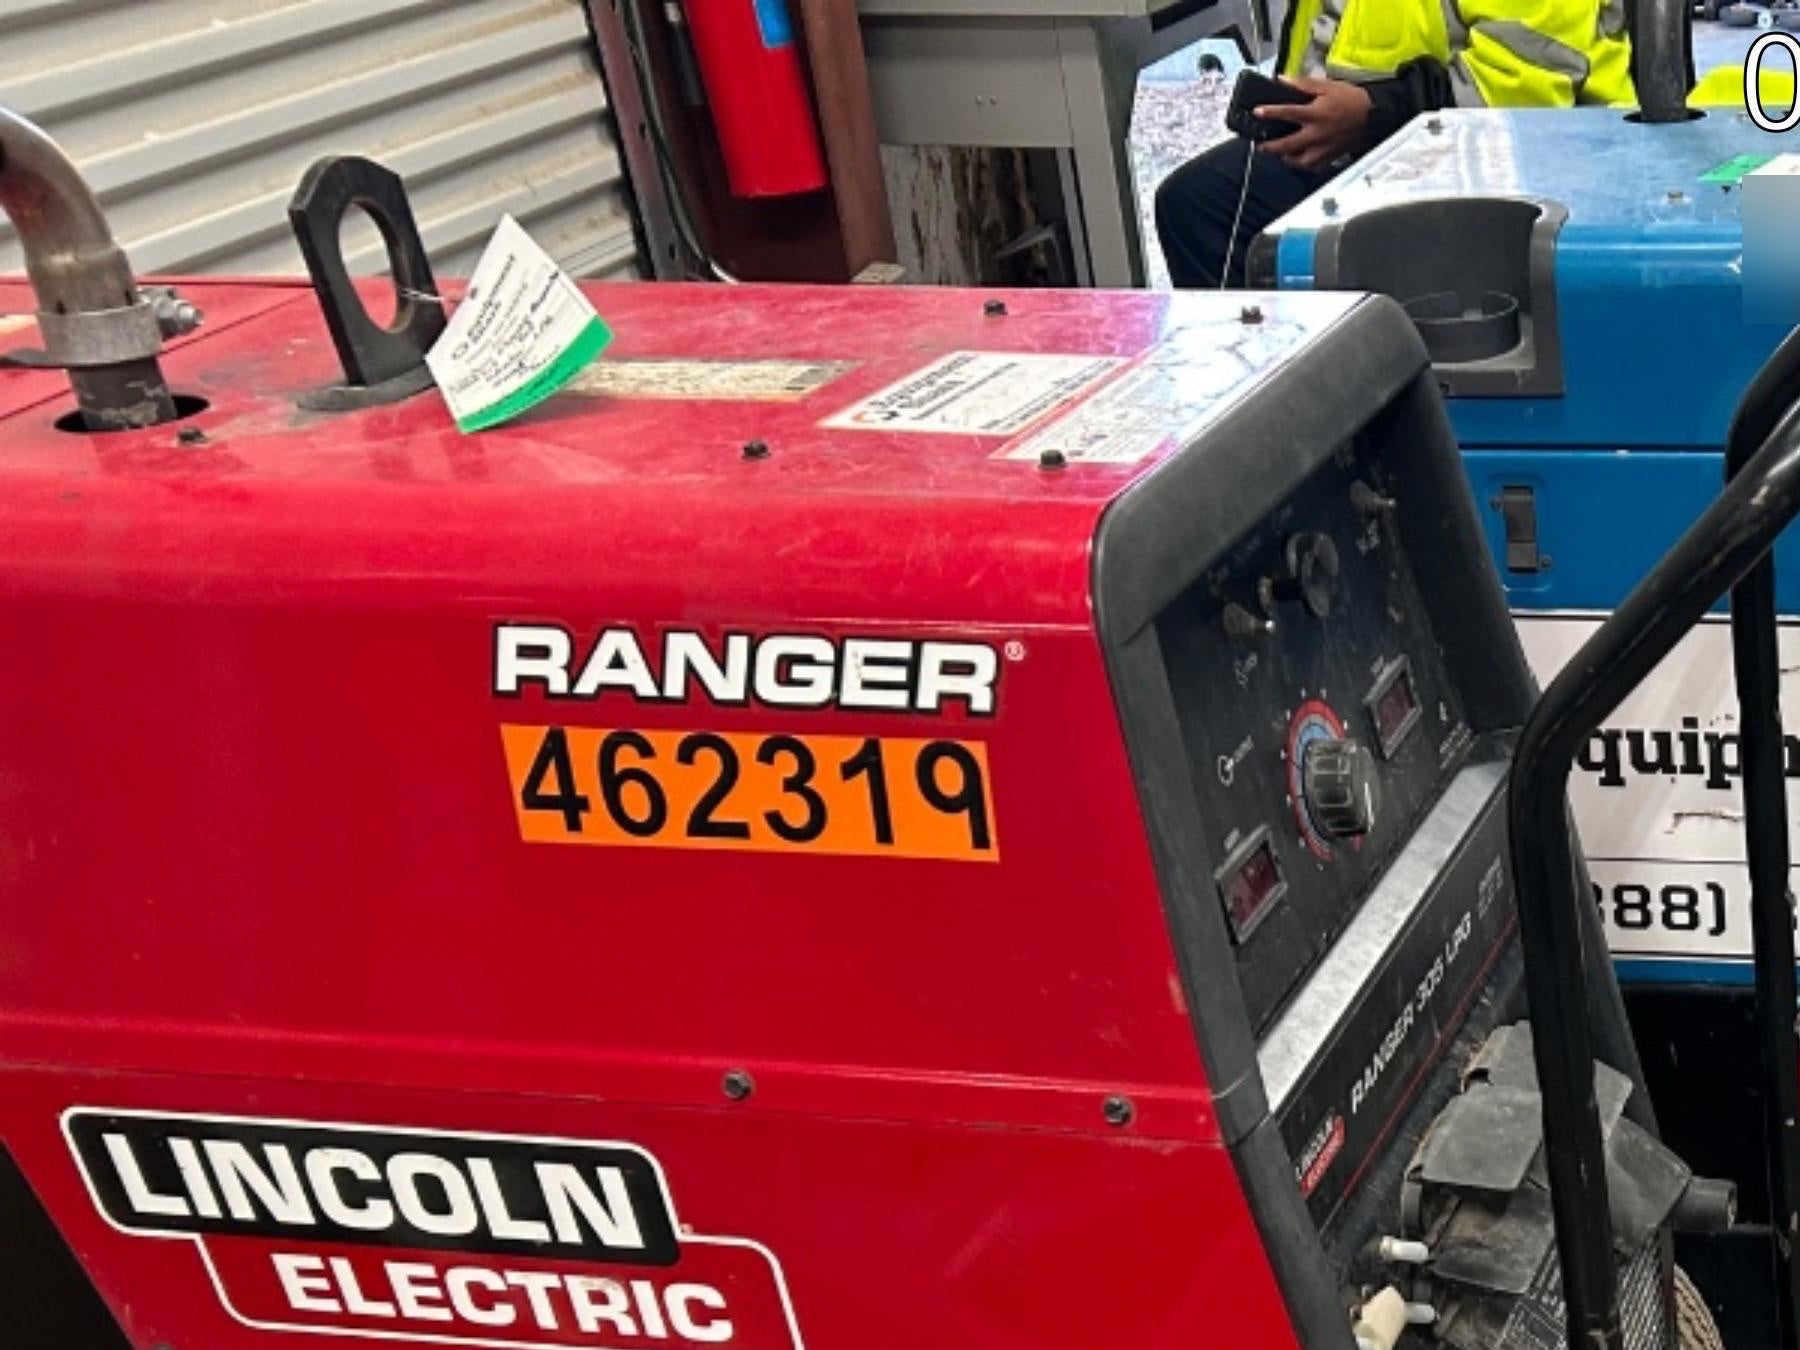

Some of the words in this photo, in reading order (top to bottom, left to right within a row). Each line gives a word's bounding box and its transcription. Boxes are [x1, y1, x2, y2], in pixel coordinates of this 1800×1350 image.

[495, 624, 1000, 714] RANGER
[520, 726, 993, 851] 462319
[1593, 881, 1728, 937] 88)
[100, 1132, 646, 1250] LINCOLN
[270, 1251, 736, 1344] ELECTRIC
